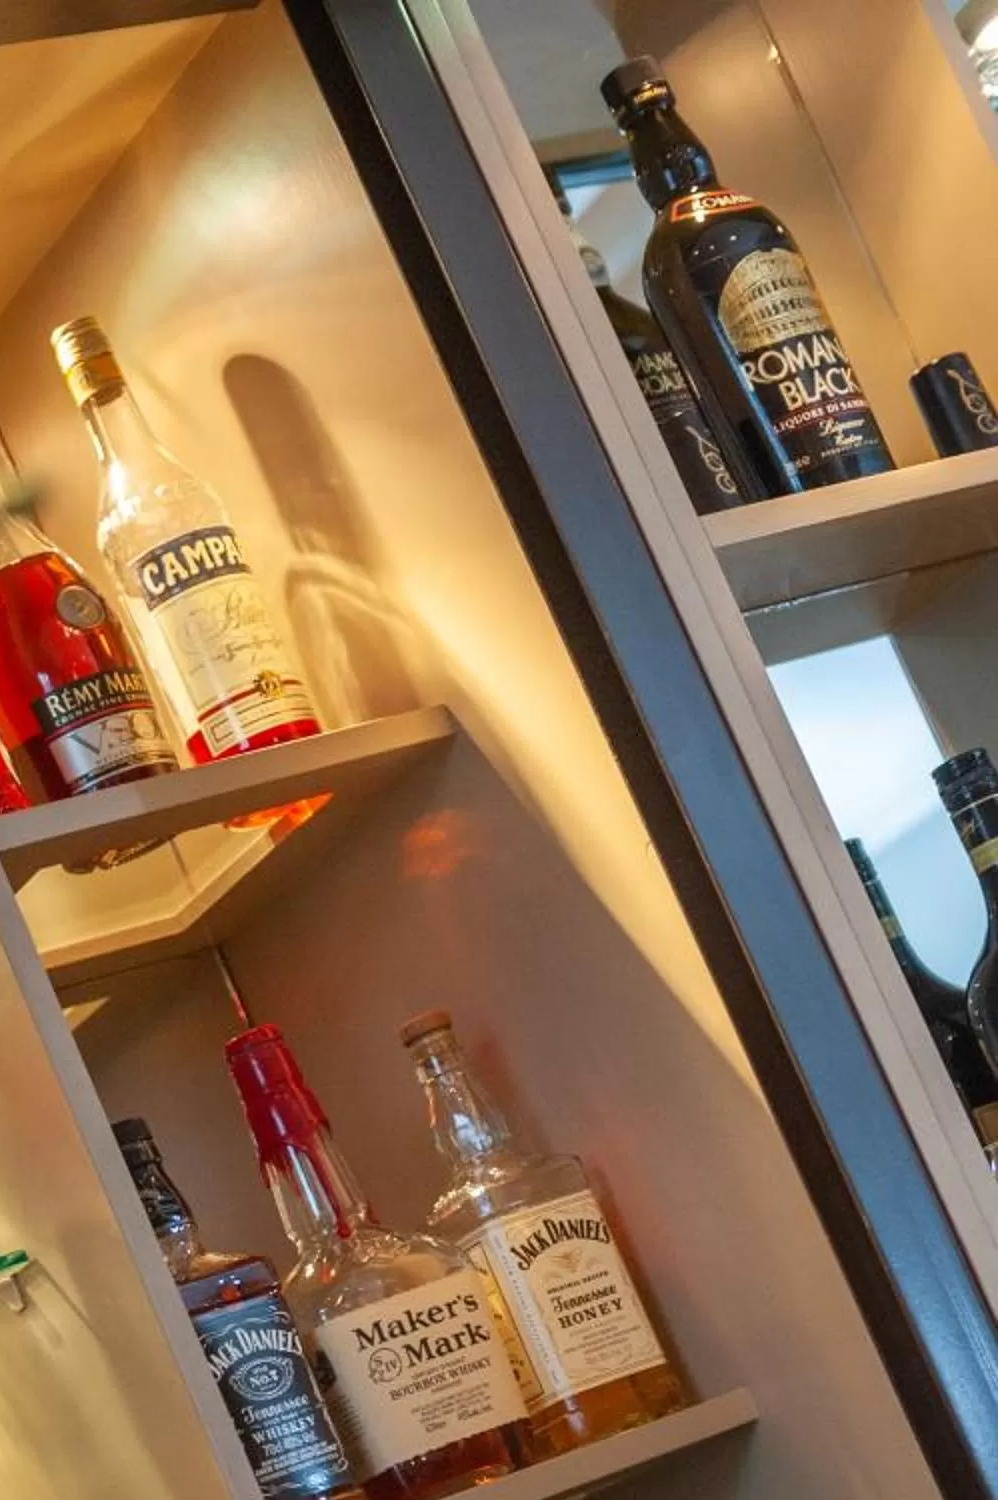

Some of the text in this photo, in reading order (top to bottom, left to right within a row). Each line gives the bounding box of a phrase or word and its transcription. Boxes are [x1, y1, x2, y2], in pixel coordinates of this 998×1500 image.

[778, 367, 862, 411] BLACK
[510, 1216, 611, 1271] JACK DANIEL'S
[352, 1294, 479, 1351] Maker's
[558, 1298, 624, 1330] HONEY
[209, 1327, 303, 1380] JACK DANIEL'S
[403, 1322, 491, 1368] Mark
[252, 1414, 316, 1445] WHISKEY
